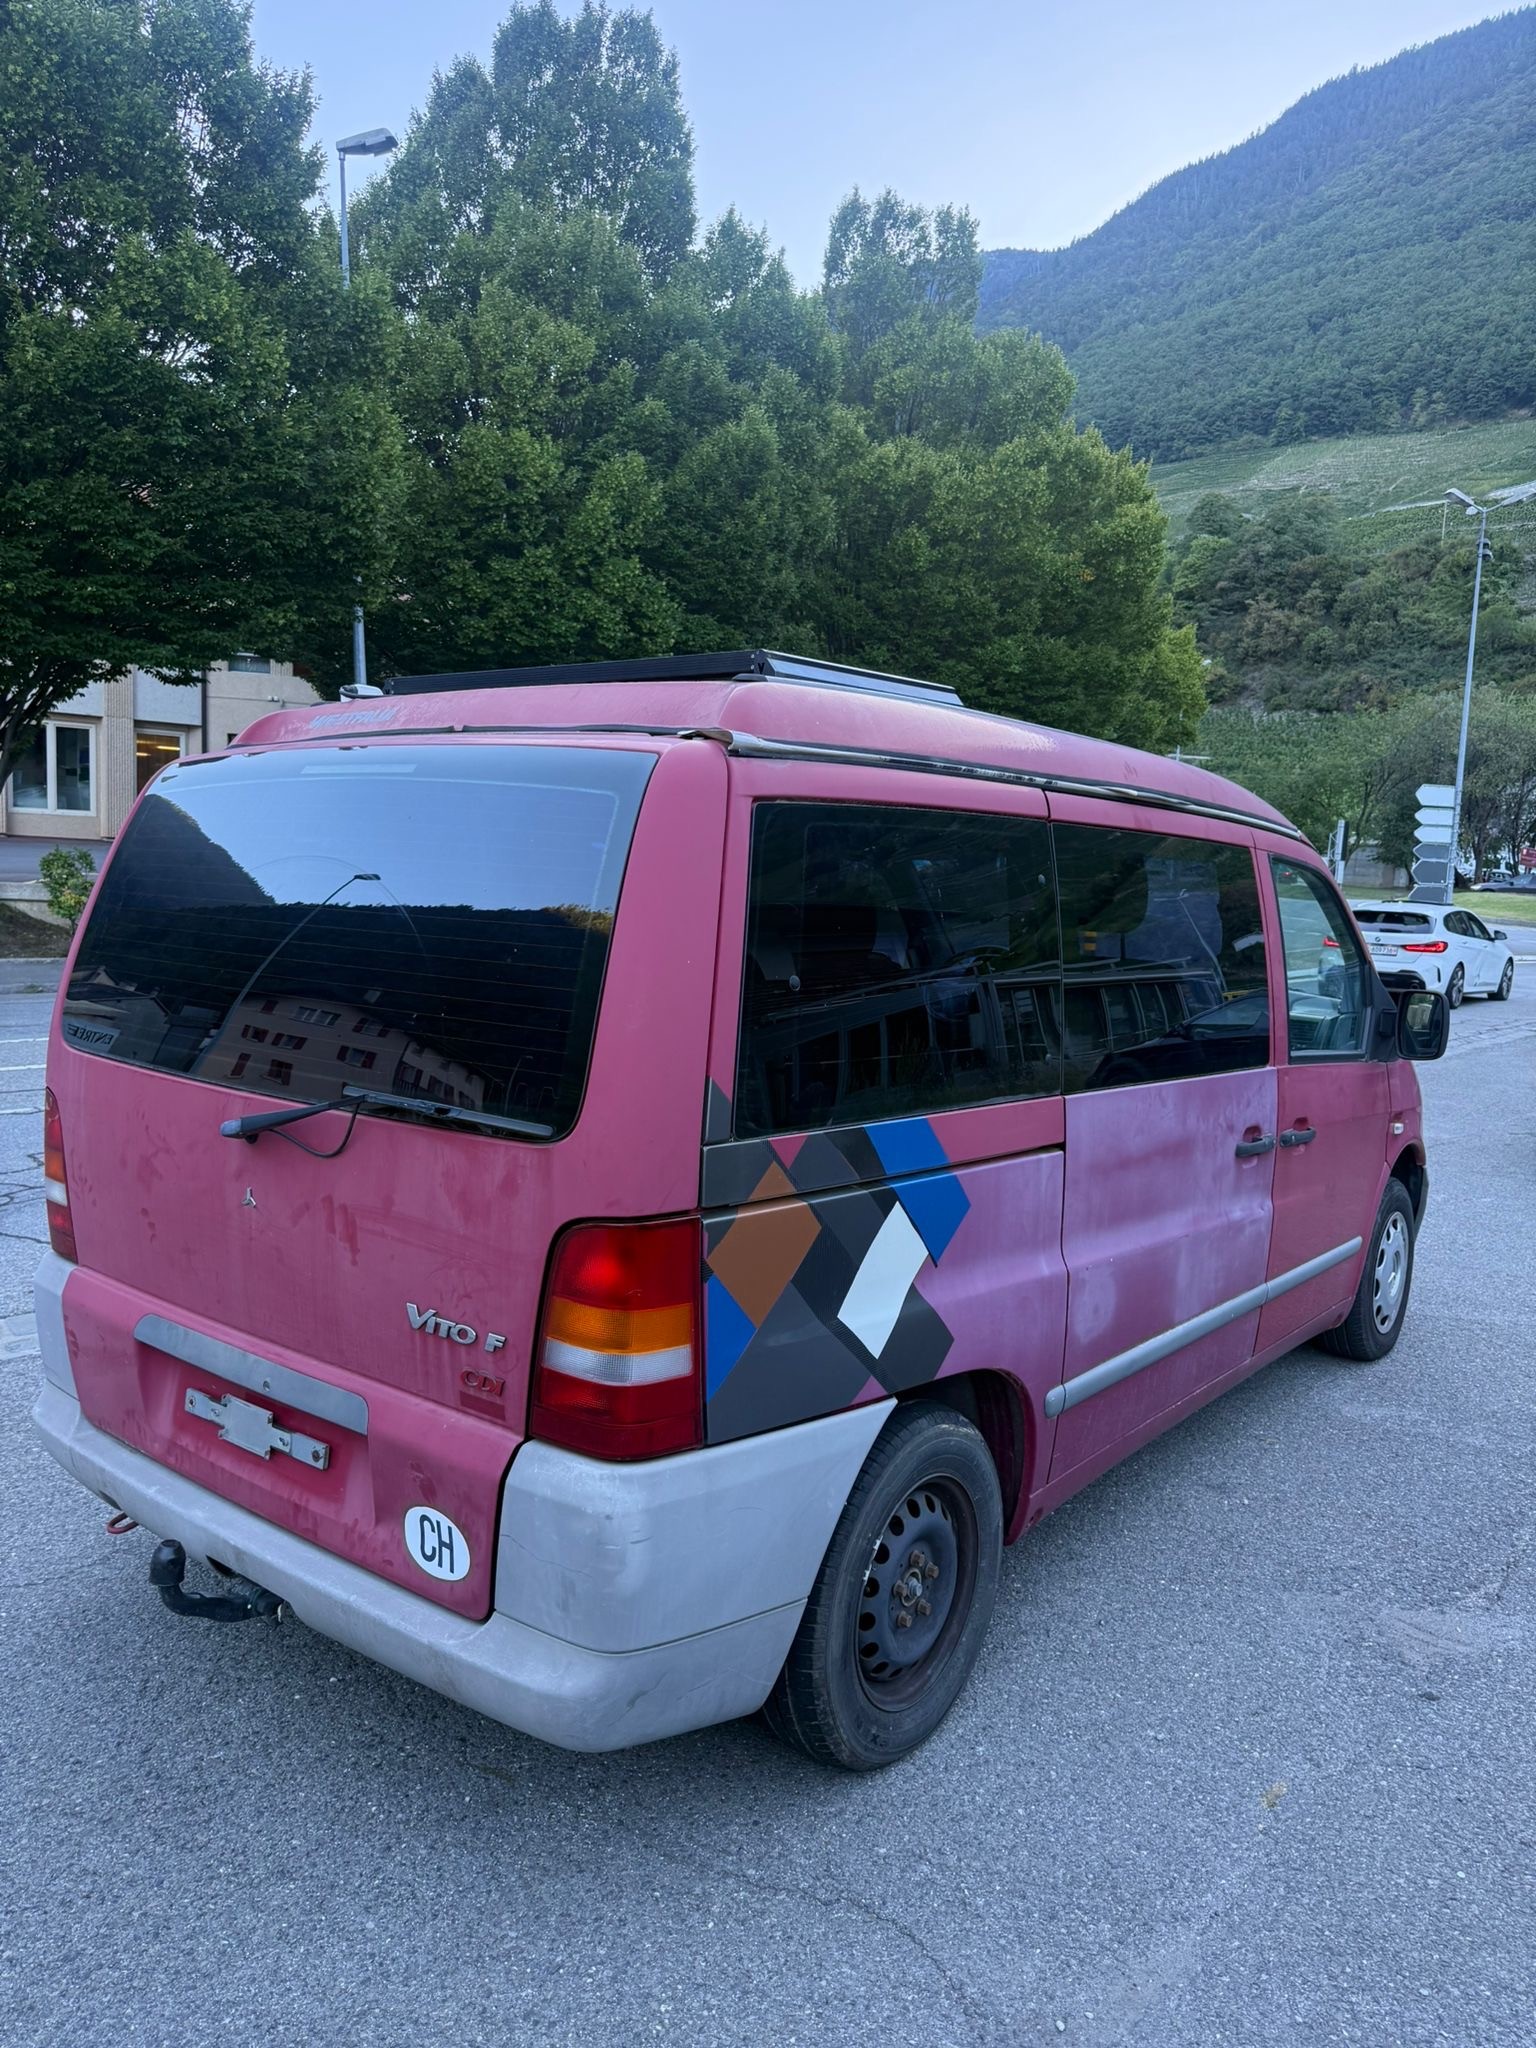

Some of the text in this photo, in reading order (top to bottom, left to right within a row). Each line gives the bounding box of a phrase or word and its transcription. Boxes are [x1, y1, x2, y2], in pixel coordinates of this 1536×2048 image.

[485, 1332, 506, 1352] F
[461, 1369, 505, 1396] CDI
[419, 1514, 455, 1574] CH
